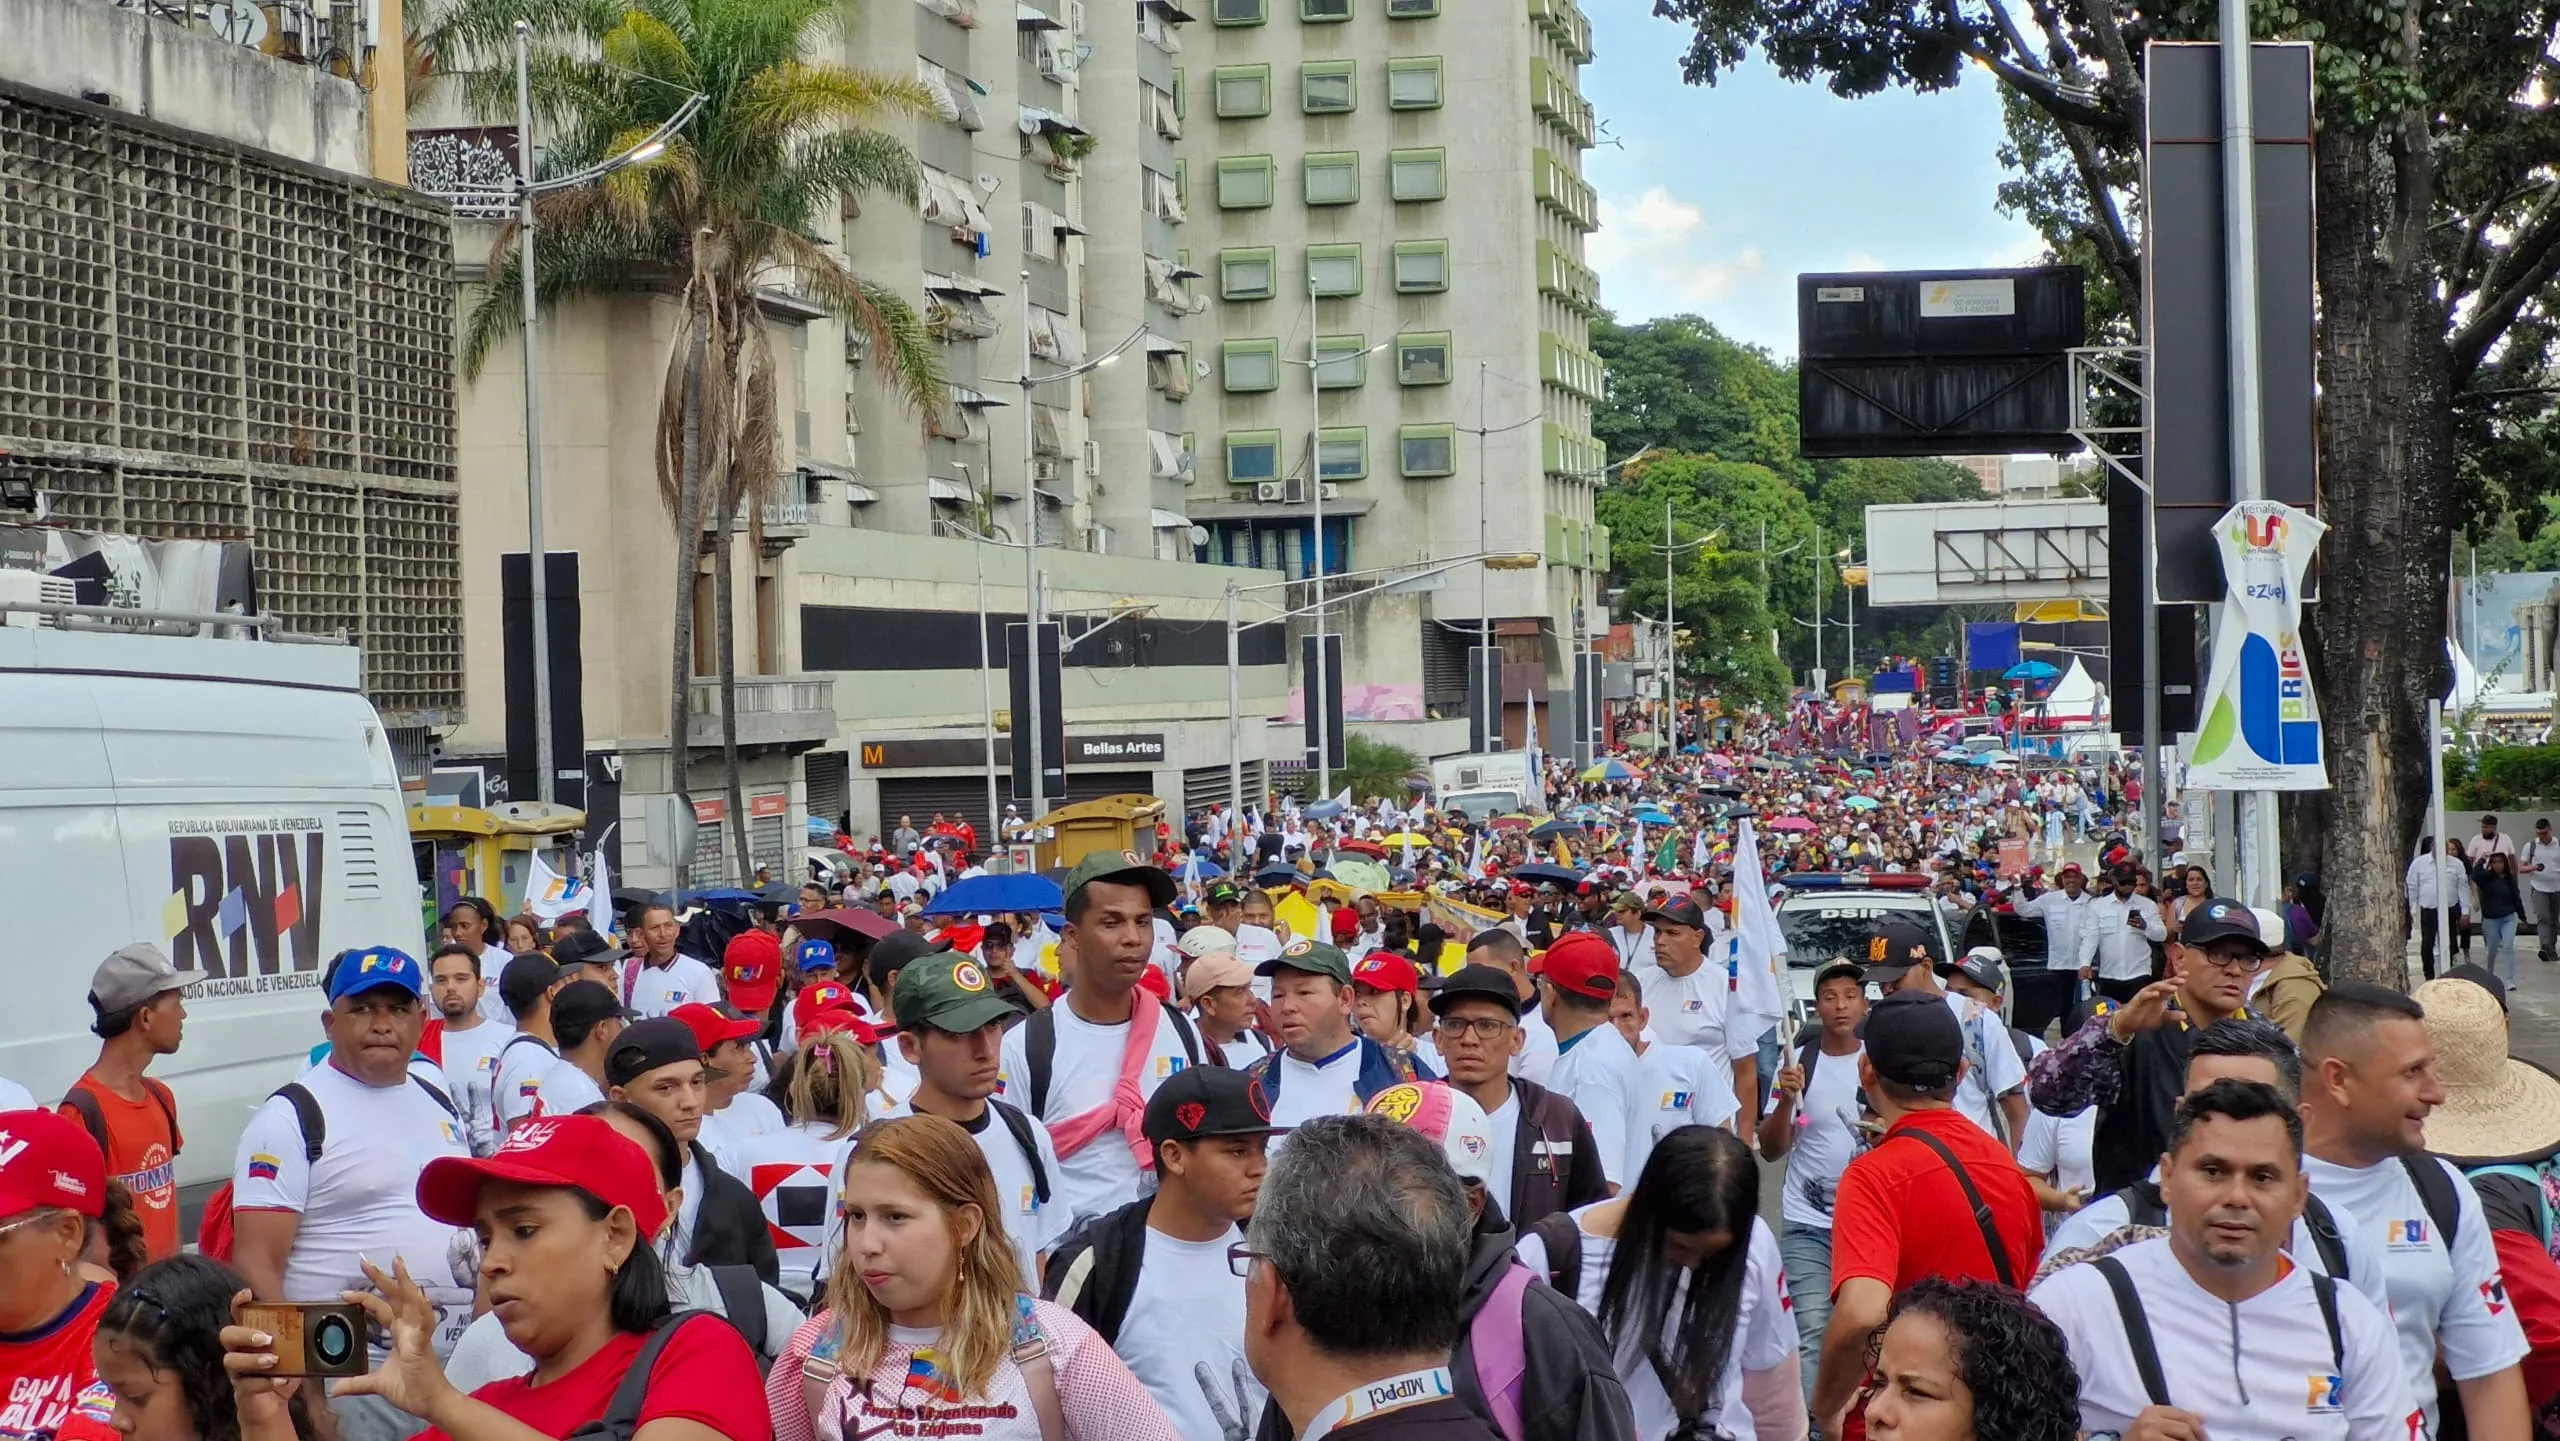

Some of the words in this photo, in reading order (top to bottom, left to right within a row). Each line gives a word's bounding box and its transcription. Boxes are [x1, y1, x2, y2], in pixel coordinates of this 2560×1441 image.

[864, 745, 883, 764] M
[1083, 742, 1123, 755] Bellas
[1126, 742, 1161, 754] Artes
[216, 819, 267, 833] BOLIVARIANA
[269, 819, 280, 832] DE
[281, 818, 323, 831] VENEZUELA
[170, 832, 324, 980] RNV
[1821, 909, 1887, 919] DSIP
[180, 983, 204, 1000] ADIO
[207, 979, 254, 997] NACIONAL
[256, 977, 269, 994] DE
[270, 974, 322, 992] VENEZUELA
[1368, 1377, 1424, 1408] MIPPCI
[861, 1401, 915, 1420] Frente
[893, 1421, 915, 1437] de
[918, 1421, 983, 1438] Mujeres
